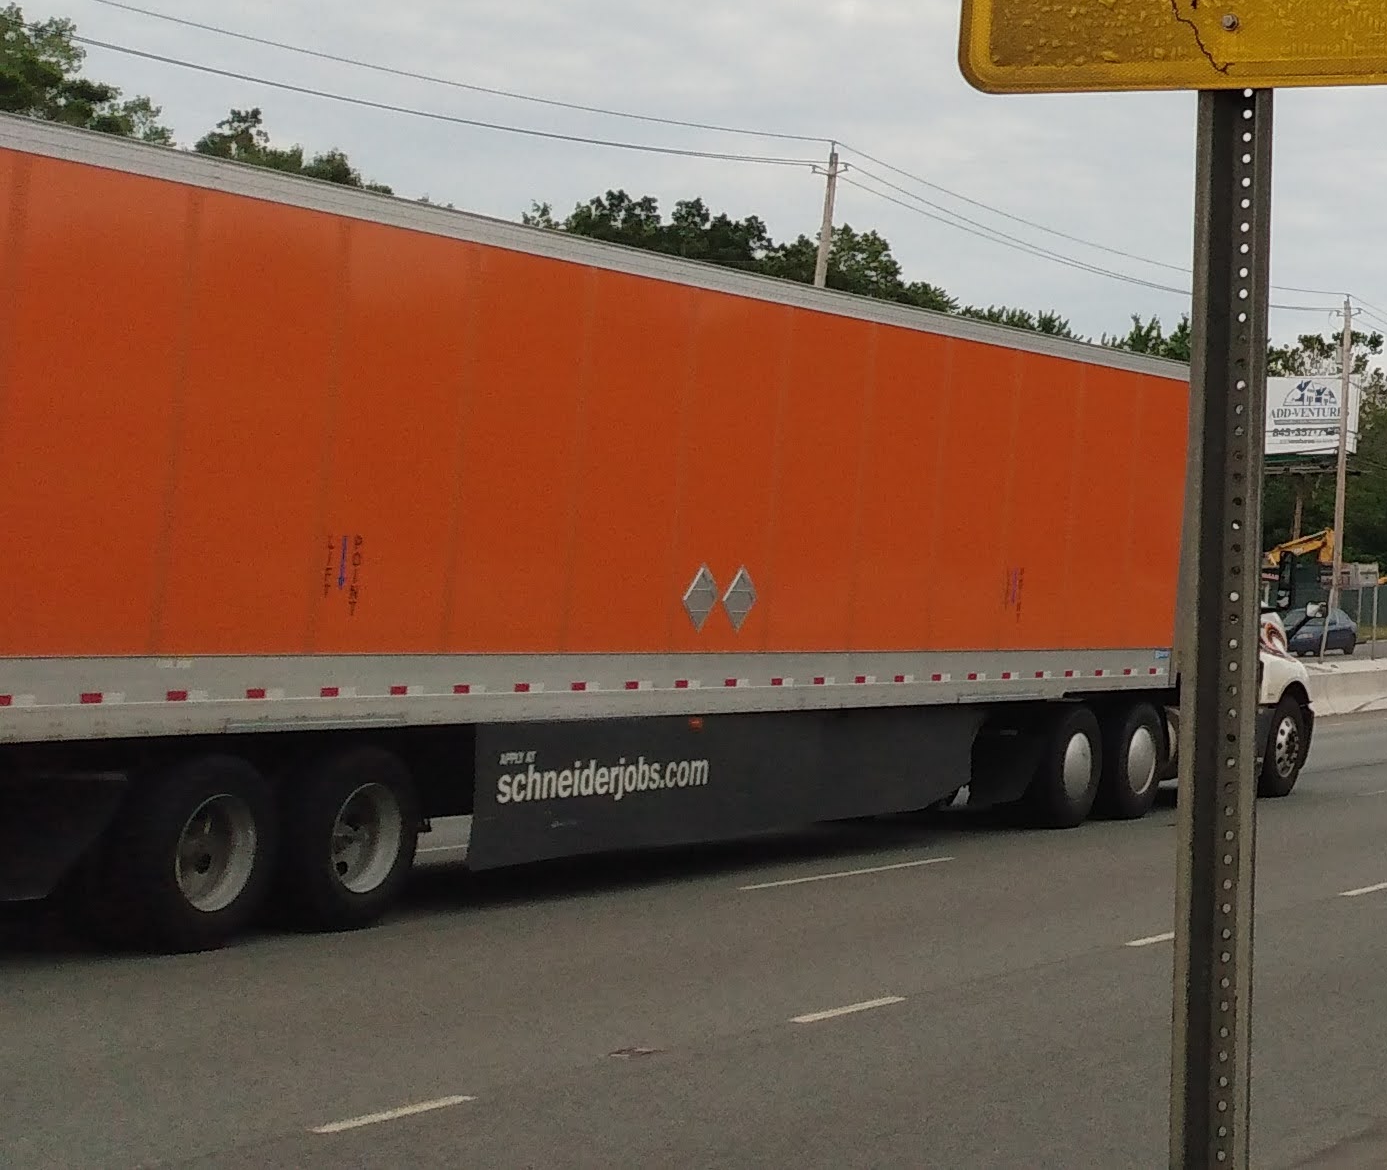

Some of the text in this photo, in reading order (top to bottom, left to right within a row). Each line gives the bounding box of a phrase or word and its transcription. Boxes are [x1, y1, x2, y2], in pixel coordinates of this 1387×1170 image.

[499, 750, 537, 766] APPLY AT
[496, 756, 710, 804] schneiderjobs.com
